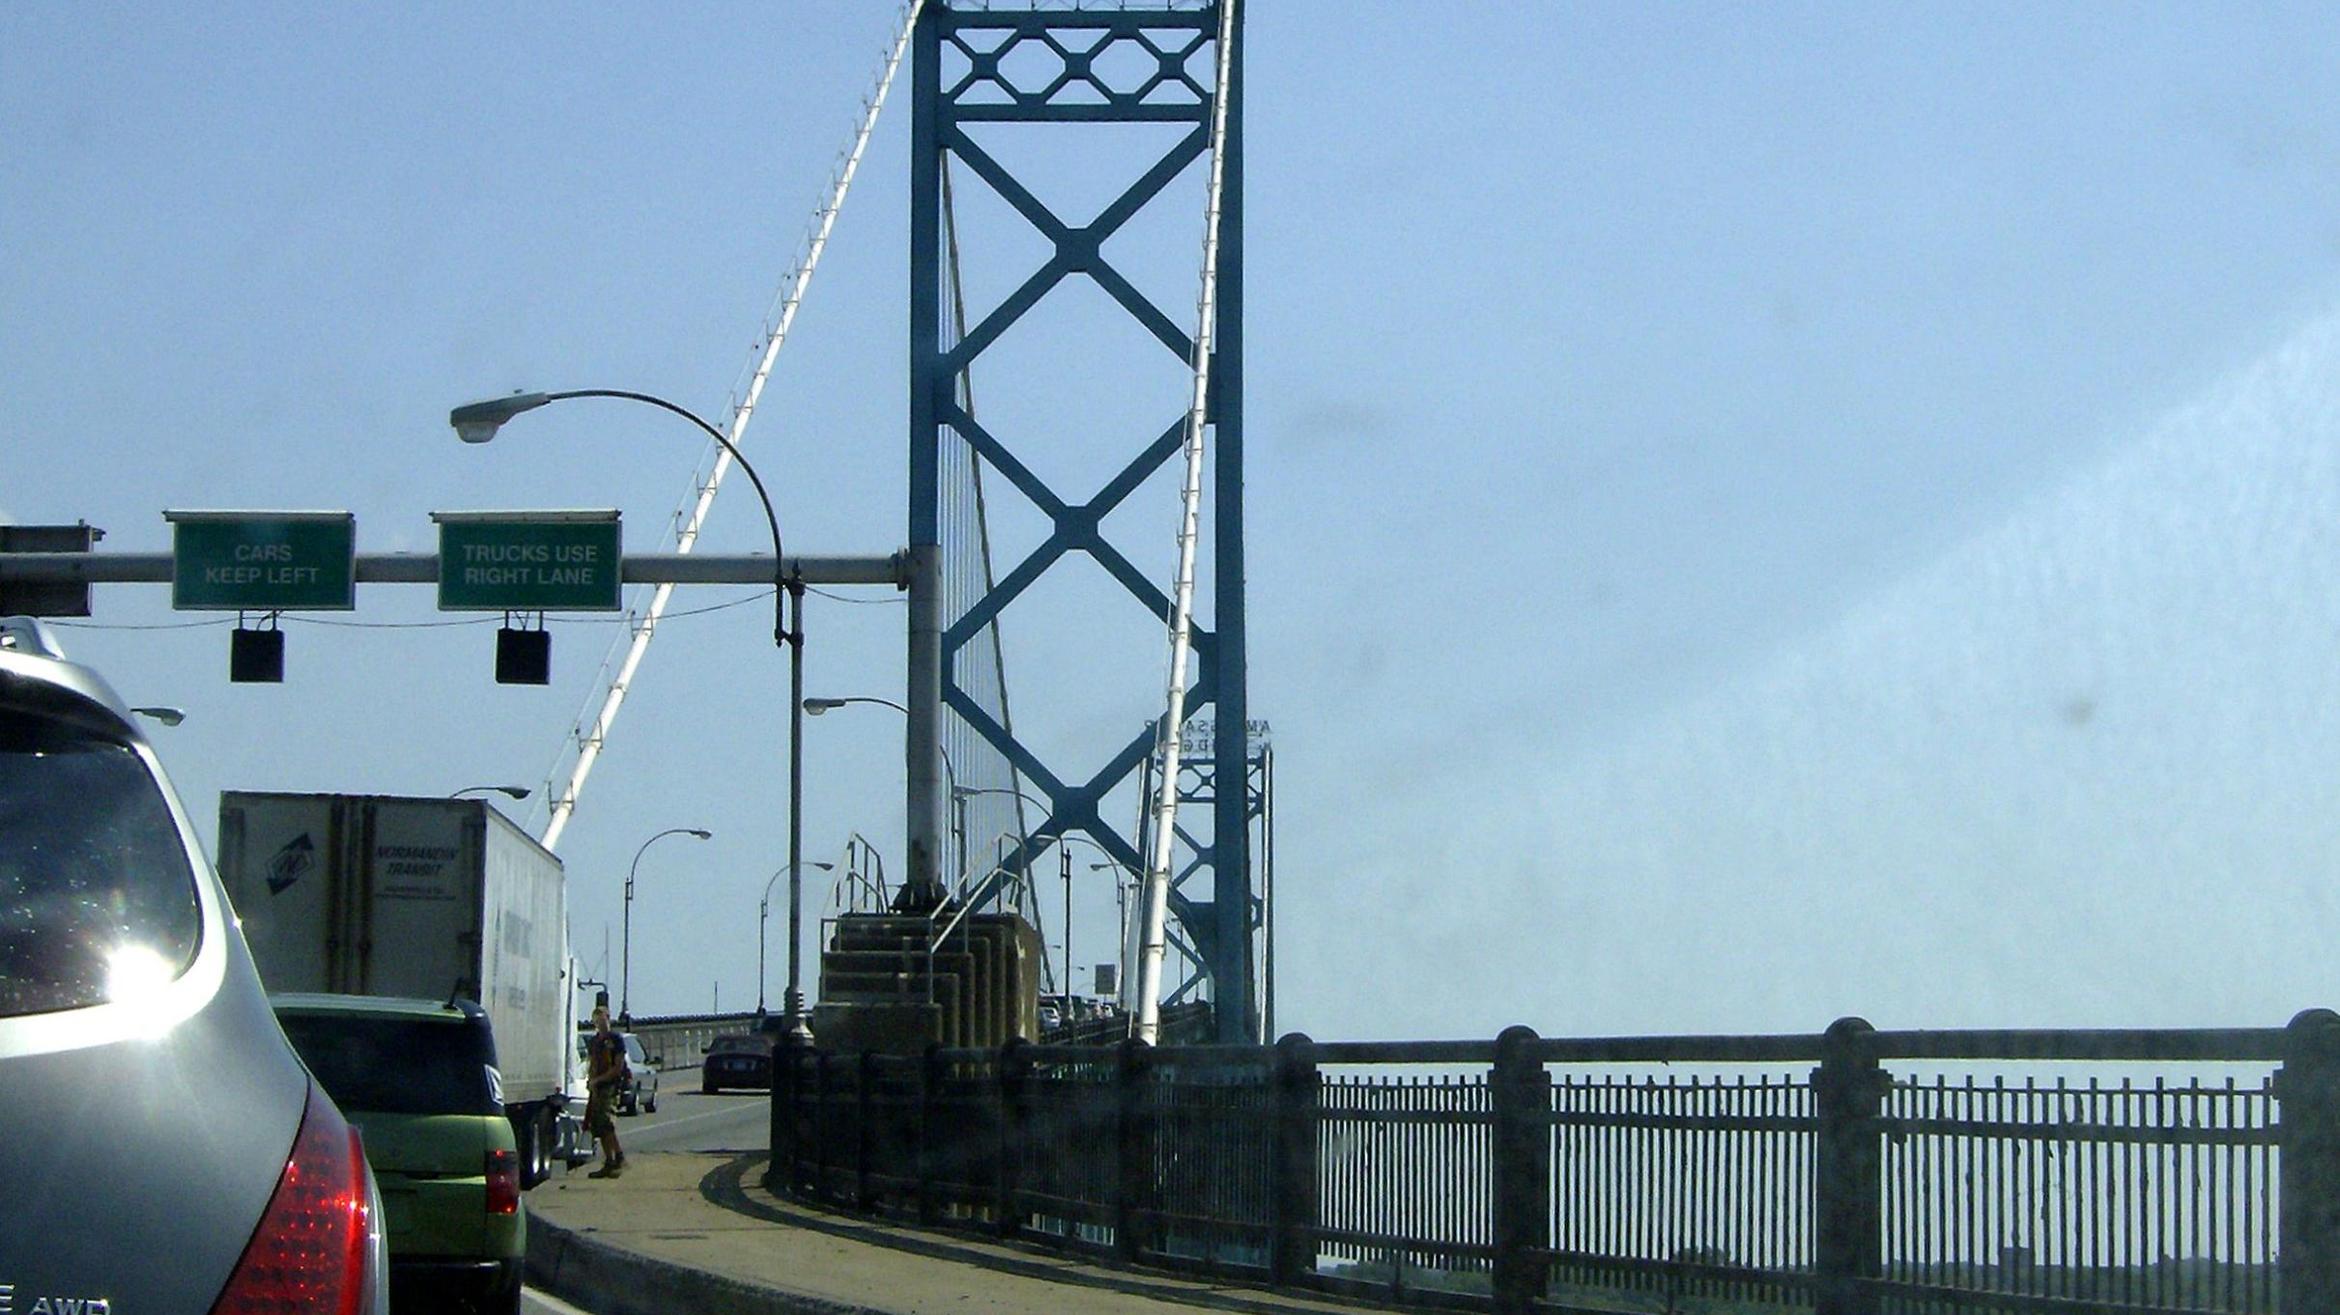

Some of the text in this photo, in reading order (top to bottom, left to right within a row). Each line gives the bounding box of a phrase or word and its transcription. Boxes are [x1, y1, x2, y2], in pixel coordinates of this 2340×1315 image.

[235, 544, 292, 562] CARS
[463, 544, 598, 562] TRUCKS USE
[206, 567, 319, 584] KEEP LEFT
[464, 568, 594, 585] RIGHT LANE
[29, 1297, 111, 1315] AWD
